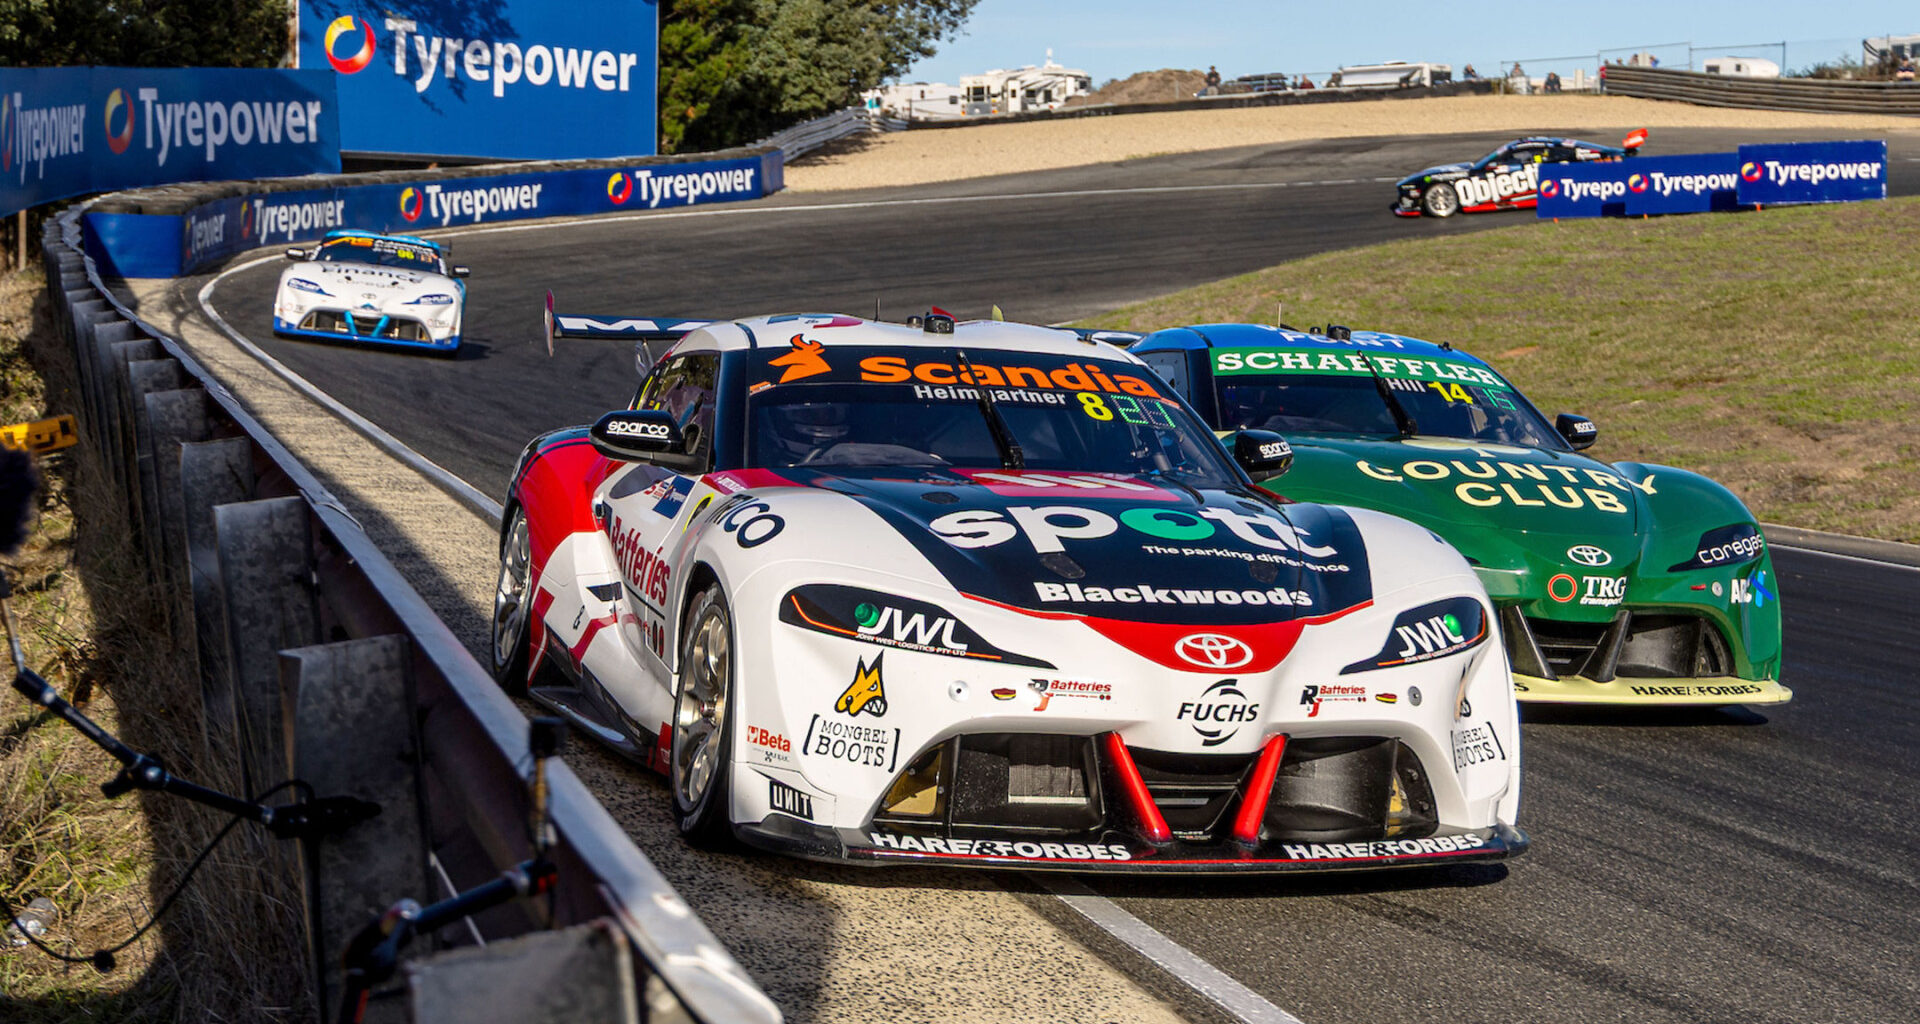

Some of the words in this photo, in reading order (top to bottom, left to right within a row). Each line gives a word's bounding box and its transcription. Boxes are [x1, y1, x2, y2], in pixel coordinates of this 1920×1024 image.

[385, 18, 637, 97] Tyrepower
[14, 92, 86, 185] Tyrepower
[139, 88, 321, 166] Tyrepower
[635, 168, 754, 207] Tyrepower
[1764, 160, 1881, 186] Tyrepower
[425, 183, 542, 226] Tyrepower
[254, 199, 345, 245] Tyrepower
[859, 356, 1162, 399] Scandia
[1217, 351, 1505, 387] SCHAEFFLER
[913, 385, 1066, 405] Heimartner
[1385, 377, 1426, 393] Hill
[1427, 380, 1473, 405] 14
[1076, 392, 1114, 422] 8
[606, 420, 670, 440] sparco
[1356, 459, 1658, 495] COUNTRY
[1454, 481, 1628, 513] CLUB
[929, 505, 1337, 558] spott
[1141, 545, 1181, 555] The
[1181, 548, 1256, 562] parking
[1698, 534, 1764, 564] coregas
[1033, 581, 1314, 606] Blackwoods
[1582, 575, 1627, 598] TRG
[856, 606, 968, 651] JWL
[1395, 616, 1465, 658] JWL
[1050, 679, 1112, 693] Batteries
[1320, 685, 1366, 695] Batteries
[1177, 702, 1259, 722] FUCHS
[758, 728, 791, 752] Beta
[820, 719, 889, 745] MONGREL
[815, 734, 886, 767] BOOTS
[773, 785, 811, 815] UNIT
[870, 832, 1132, 860] HARE&FORBES
[1283, 833, 1484, 859] HARE&FORBES
